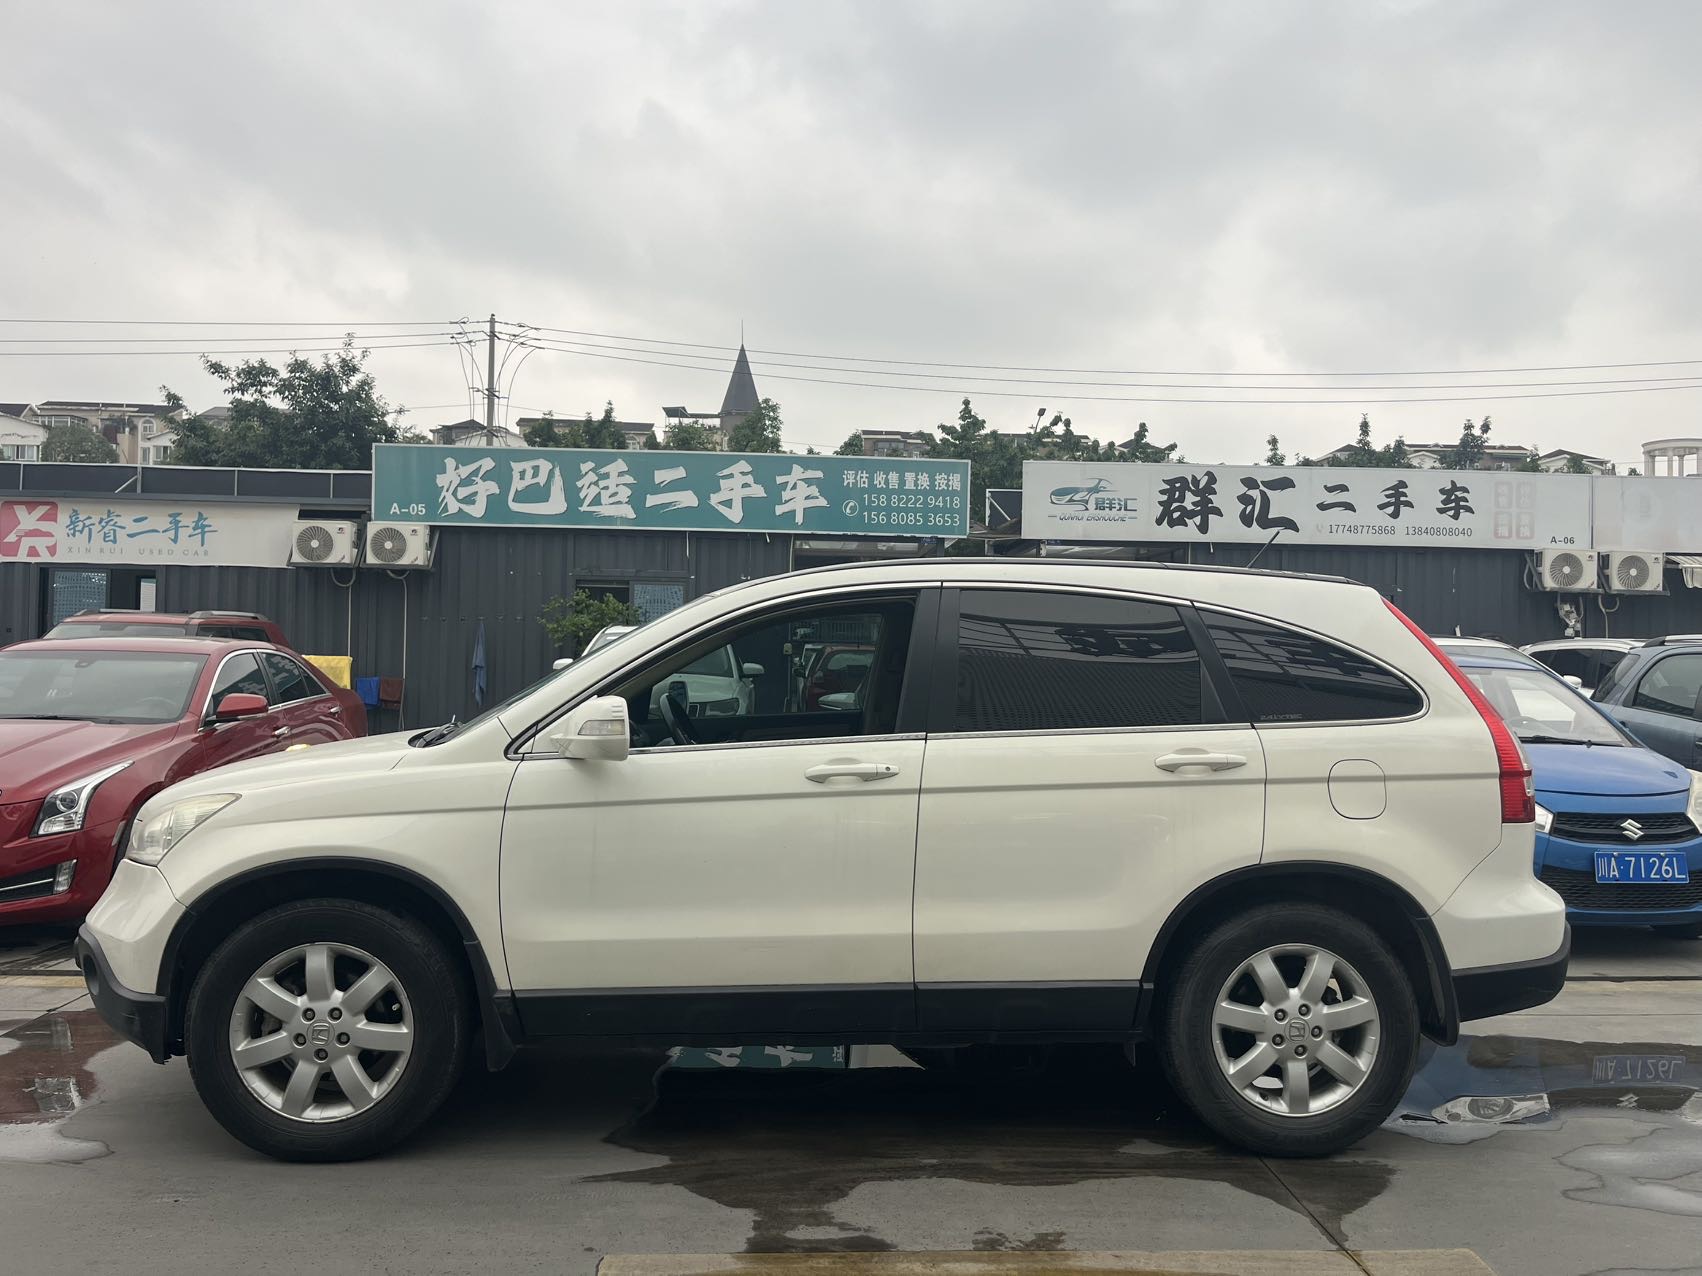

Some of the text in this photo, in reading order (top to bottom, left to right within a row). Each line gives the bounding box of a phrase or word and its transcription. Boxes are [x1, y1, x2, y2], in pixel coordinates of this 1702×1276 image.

[842, 470, 961, 491] 评估 收售 置换 按揭
[436, 456, 830, 526] 好巴适二手车
[390, 502, 426, 516] A-05
[863, 494, 960, 509] 158 8222 9418
[1094, 497, 1138, 511] 群汇
[1155, 471, 1475, 535] 群汇二手车
[863, 511, 960, 526] 156 8085 3653
[65, 508, 218, 547] 新睿二手车
[1328, 524, 1473, 537] 17748775868 13840808040
[1550, 536, 1576, 545] A-06
[67, 546, 209, 557] XIN RUI USED CAR
